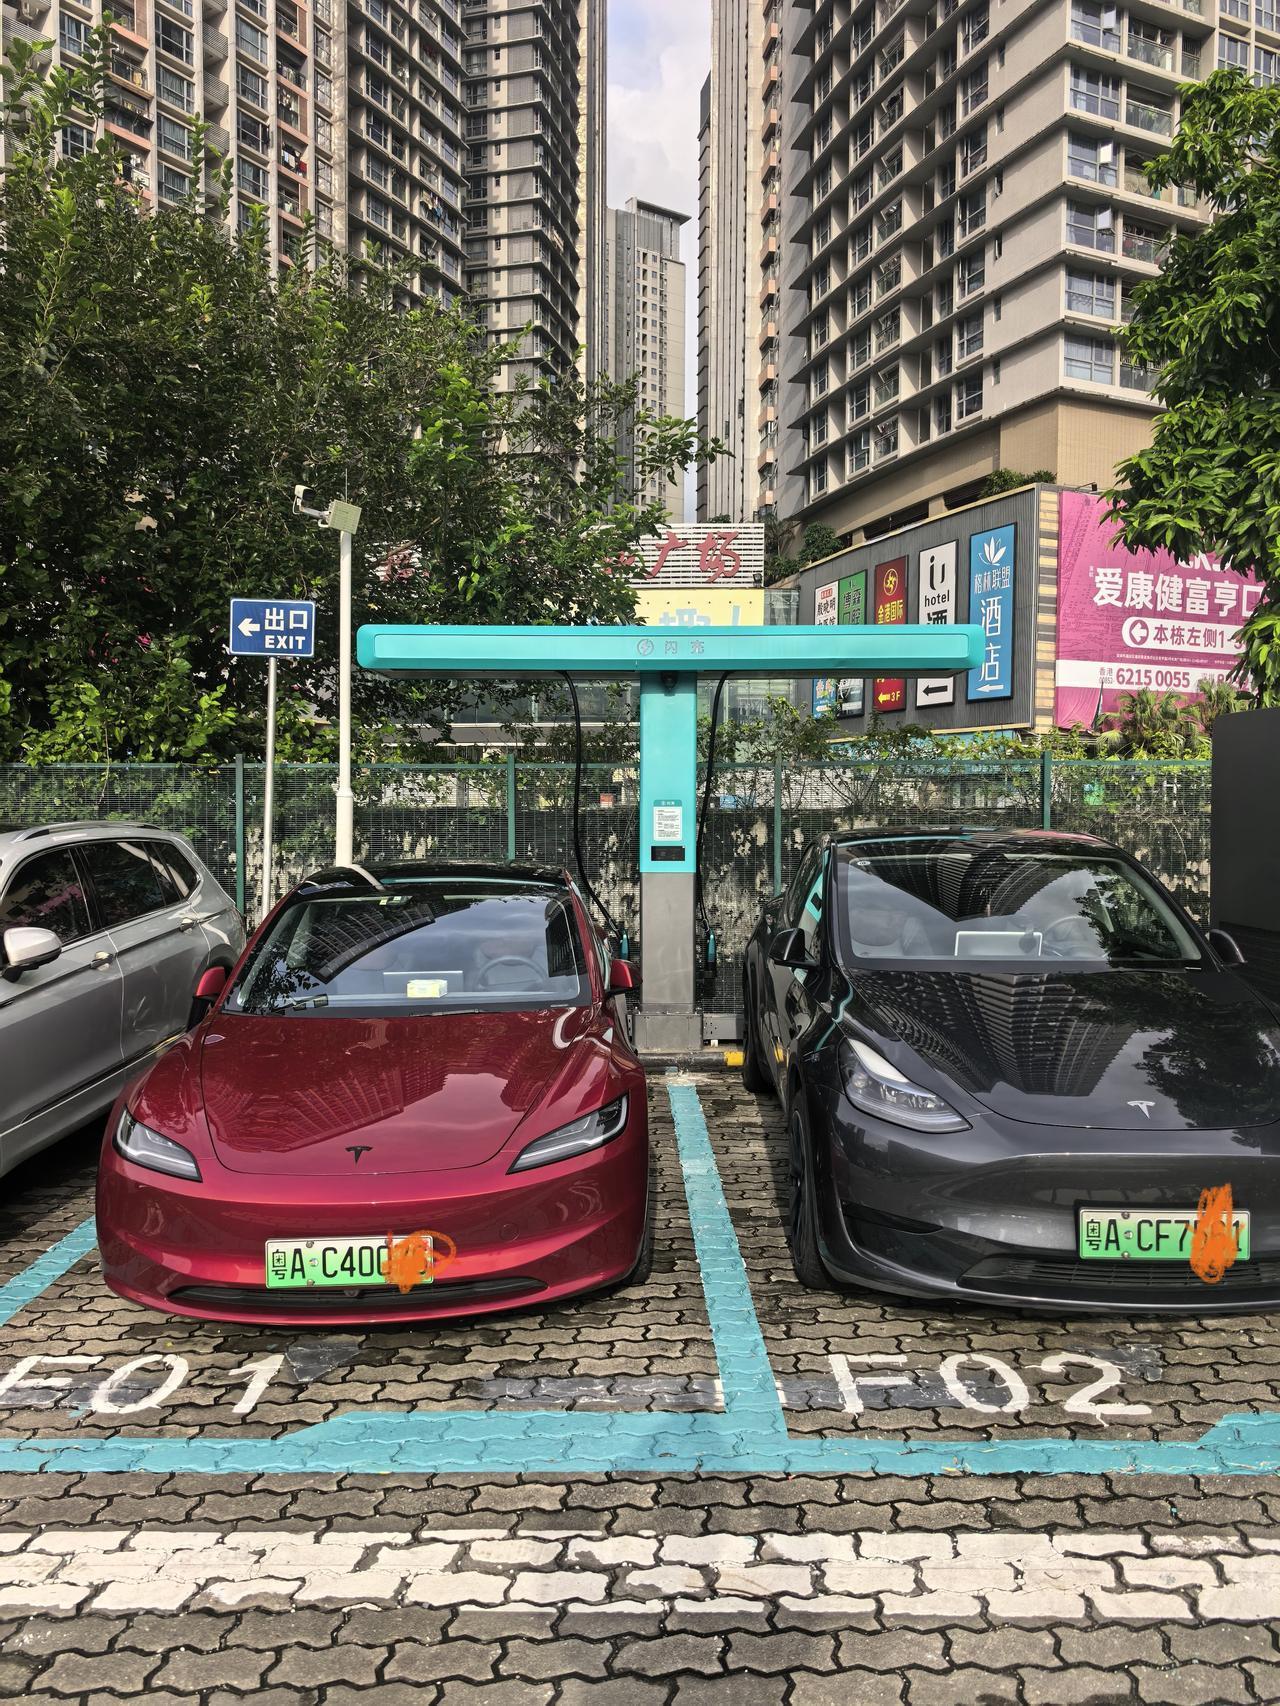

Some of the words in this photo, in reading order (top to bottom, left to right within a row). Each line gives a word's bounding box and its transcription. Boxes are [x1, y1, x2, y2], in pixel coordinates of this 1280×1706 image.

[974, 565, 1011, 594] 格林联盟
[924, 589, 950, 607] hotel
[264, 607, 308, 631] 出口
[264, 635, 306, 649] EXIT
[1116, 667, 1152, 687] 6215
[1155, 670, 1190, 689] 0055
[890, 691, 901, 702] 3F
[826, 1352, 1153, 1416] F02
